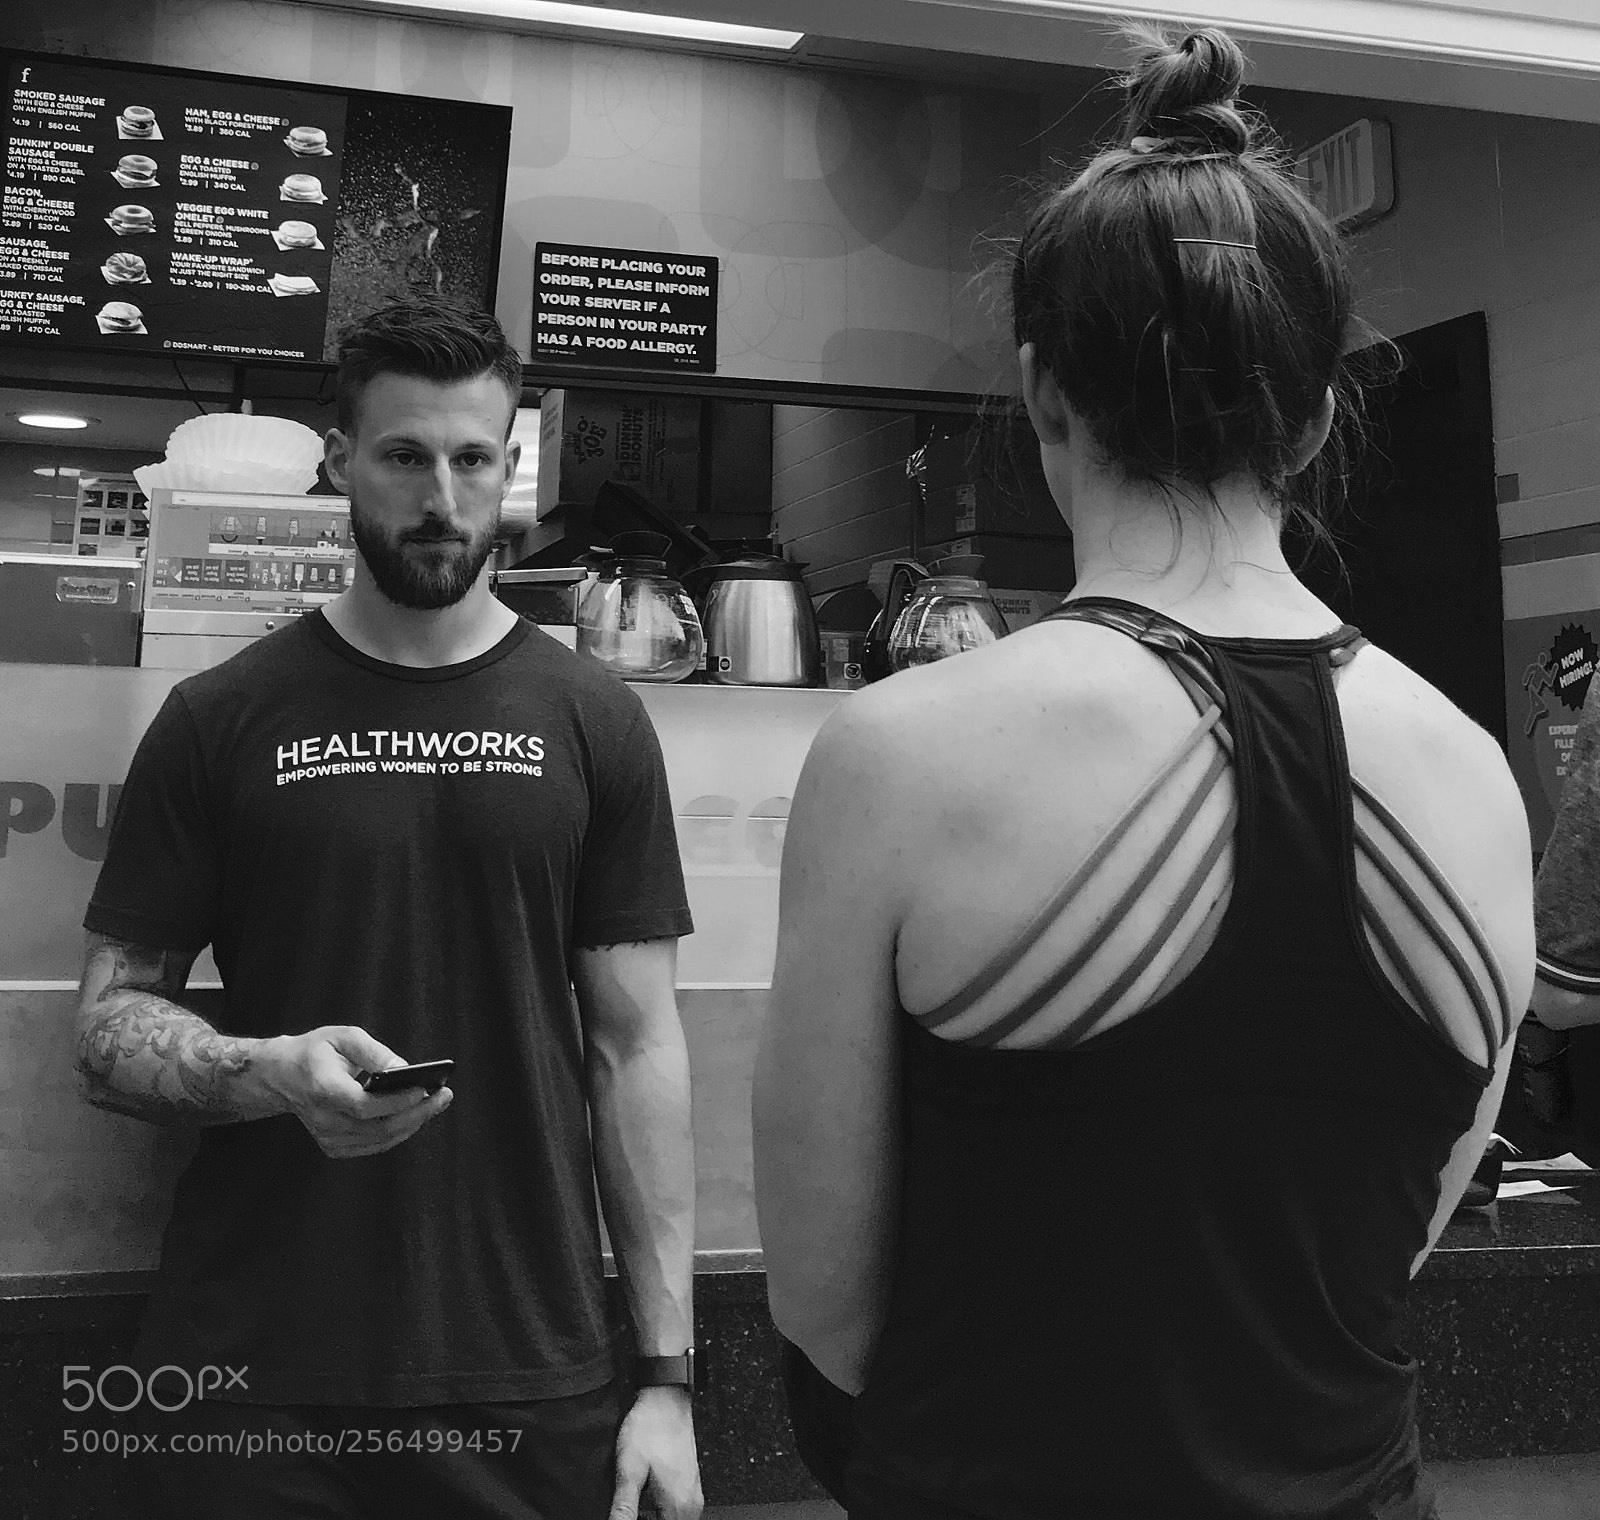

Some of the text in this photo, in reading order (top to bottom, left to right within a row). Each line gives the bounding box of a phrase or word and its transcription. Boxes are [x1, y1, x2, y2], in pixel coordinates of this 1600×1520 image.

[14, 89, 105, 106] SMOKED SAUSAGE
[14, 98, 32, 106] WITH
[57, 101, 84, 111] CHEESE
[38, 107, 68, 116] ENGLISH
[69, 110, 96, 119] MUFFIN
[185, 108, 210, 118] HAM,
[212, 111, 232, 120] EGG
[243, 114, 280, 125] CHEESE
[65, 124, 81, 132] CAL
[205, 118, 227, 126] BLACK
[229, 121, 255, 129] FOREST
[235, 129, 251, 138] CAL
[9, 138, 94, 153] DUNKIN' DOUBLE
[8, 147, 55, 158] SAUSAGE
[51, 160, 78, 168] CHEESE
[181, 155, 202, 164] EGG
[213, 158, 249, 169] CHEESE
[27, 165, 60, 174] TOASTED
[61, 168, 85, 176] BAGEL
[179, 170, 236, 181] ENGLISH MUFFIN
[199, 166, 231, 174] TOASTED
[59, 176, 76, 184] CAL
[5, 186, 43, 198] BACON,
[4, 196, 24, 205] EGG
[36, 199, 74, 209] CHEESE
[23, 206, 75, 216] CHERRYWOOD
[176, 202, 269, 219] VEGGIE EGG WHITE
[2, 211, 59, 222] SMOKED BACON
[175, 212, 215, 223] OMELET
[180, 228, 204, 236] GREEN
[205, 230, 232, 238] ONIONS
[226, 225, 270, 235] MUSHROOMS
[0, 237, 49, 249] SAUSAGE,
[223, 240, 239, 248] CAL
[31, 250, 69, 260] CHEESE
[172, 252, 218, 263] WAKE-UP
[18, 257, 49, 265] FRESHLY
[541, 253, 706, 277] BEFORE PLACING YOUR
[23, 265, 64, 273] CROISSANT
[170, 261, 265, 274] YOUR FAVORITE SANDWICH
[212, 272, 232, 280] RIGHT
[257, 285, 272, 293] CAL
[540, 273, 709, 296] ORDER, PLEASE INFORM
[36, 293, 85, 305] SAUSAGE,
[540, 292, 671, 313] YOUR SERVER IF A
[0, 300, 14, 308] GG
[26, 302, 64, 312] CHEESE
[24, 317, 50, 325] MUFFIN
[538, 313, 707, 335] PERSON IN YOUR PARTY
[538, 333, 697, 355] HAS A FOOD ALLERGY.
[1561, 648, 1584, 669] NOW
[1559, 661, 1593, 688] HIRING!
[277, 731, 545, 769] HEALTHWORKS
[276, 761, 542, 785] EMPOWERING WOMEN TO BE STRONG
